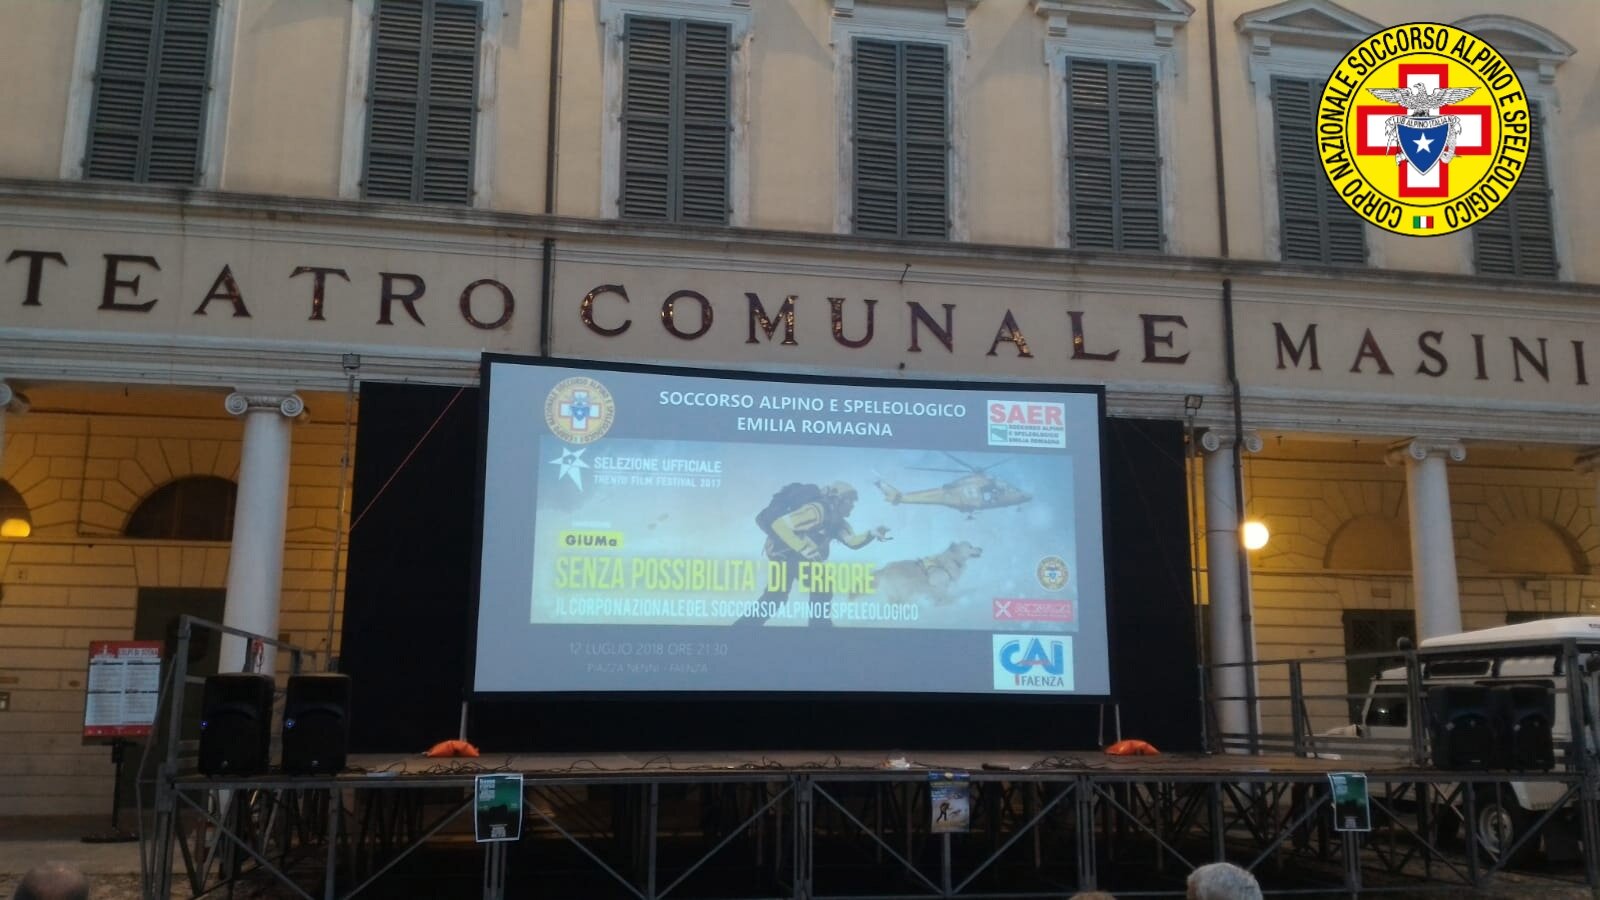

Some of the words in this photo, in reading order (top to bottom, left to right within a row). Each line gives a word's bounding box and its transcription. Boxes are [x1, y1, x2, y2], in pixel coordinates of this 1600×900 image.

[5, 250, 515, 331] TEATRO
[580, 284, 1191, 364] COMUNALE
[1272, 321, 1589, 386] MASINI
[659, 391, 754, 408] SOCCORSO
[759, 395, 824, 412] ALPINO
[829, 399, 838, 412] E
[843, 399, 967, 418] SPELEOLOGICO
[991, 403, 1063, 426] SAER
[737, 416, 796, 433] EMILIA
[801, 419, 893, 437] ROMAGNA
[594, 456, 659, 471] SELEZIONE
[663, 459, 722, 473] UFFICIALE
[594, 474, 626, 485] TRENTO
[631, 475, 652, 486] FILM
[656, 476, 697, 488] FESTIVAL
[700, 478, 721, 489] 2017
[556, 556, 625, 590] SENZA
[767, 560, 787, 593] DI
[798, 561, 876, 594] ERRORE
[711, 599, 776, 619] SOCCORSO
[776, 601, 823, 619] ALPINO
[832, 602, 919, 621] SPELEOLOGICO
[570, 642, 582, 656] 12
[585, 642, 632, 656] LUGLIO
[634, 642, 664, 656] 2018
[668, 642, 695, 656] ORE
[1000, 637, 1064, 676] CAI
[587, 663, 623, 673] PIAZZA
[1021, 675, 1064, 687] FAENZA
